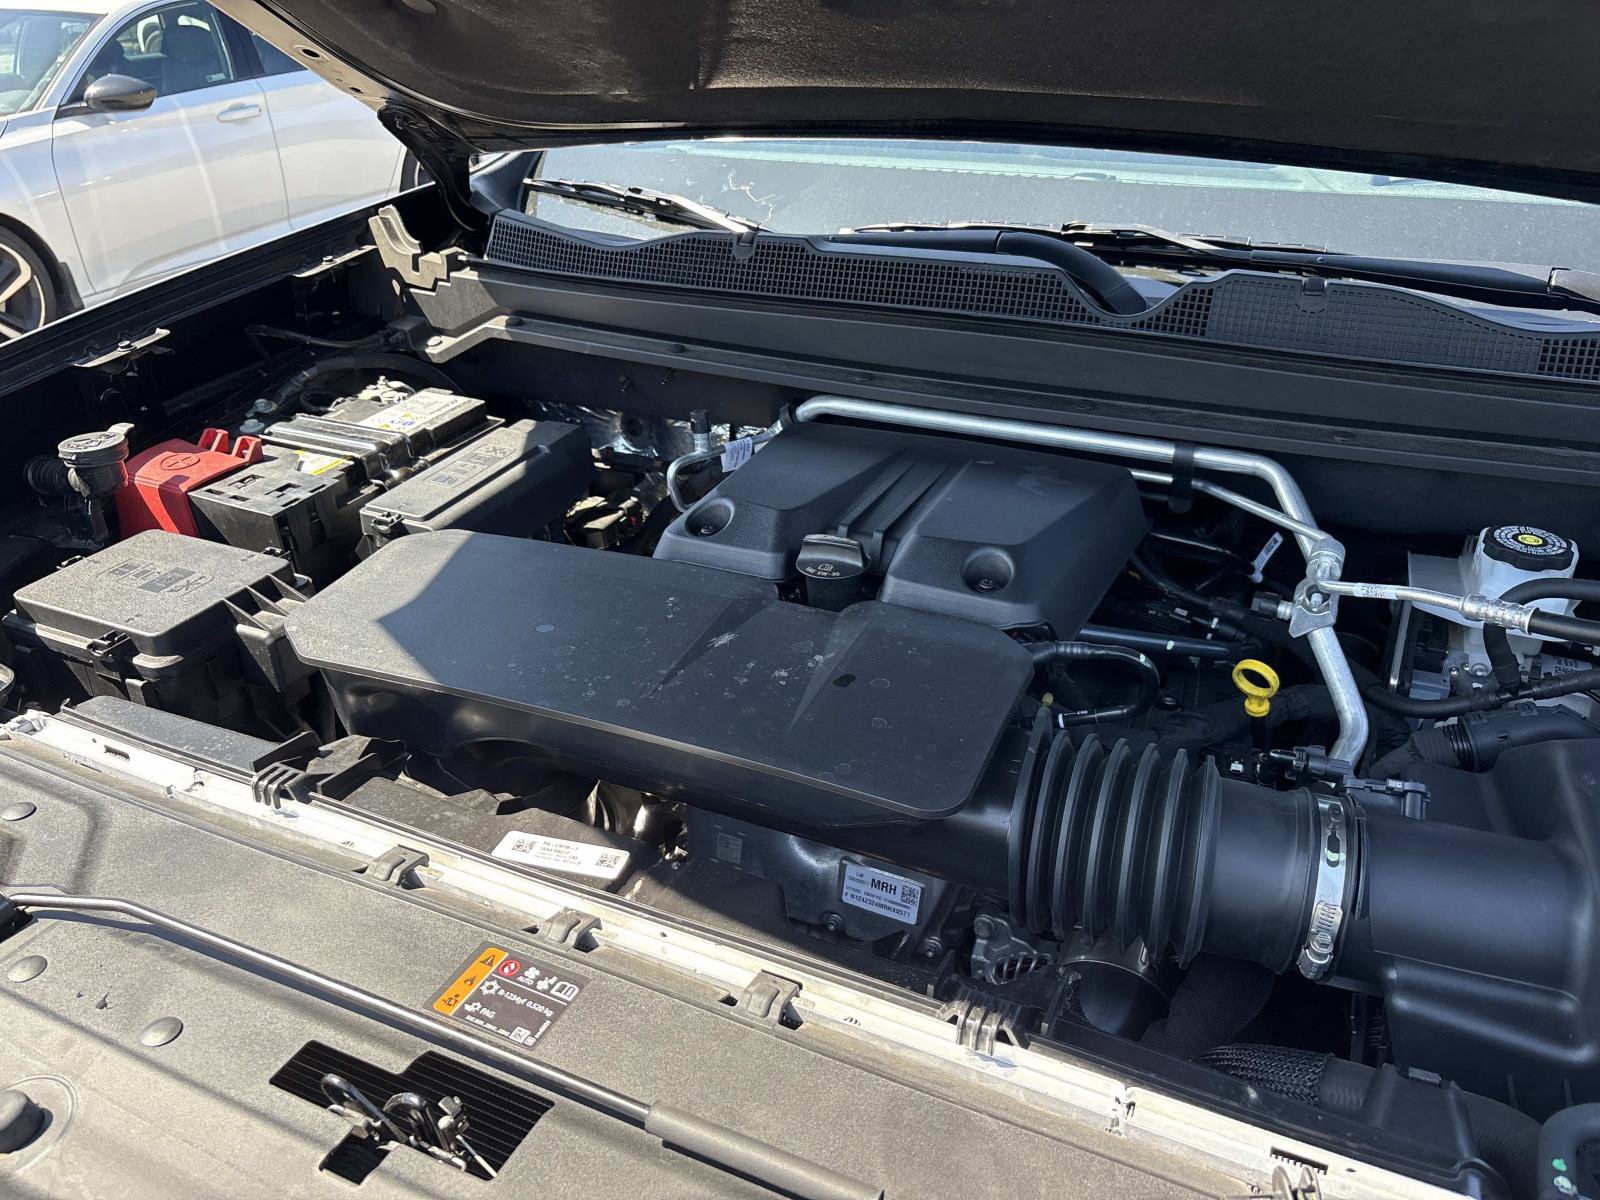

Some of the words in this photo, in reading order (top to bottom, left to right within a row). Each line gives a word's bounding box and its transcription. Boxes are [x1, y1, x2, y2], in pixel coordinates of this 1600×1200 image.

[870, 877, 898, 896] MRH
[516, 975, 534, 986] AUTO
[479, 1007, 497, 1019] PAG
[544, 1006, 555, 1017] kg
